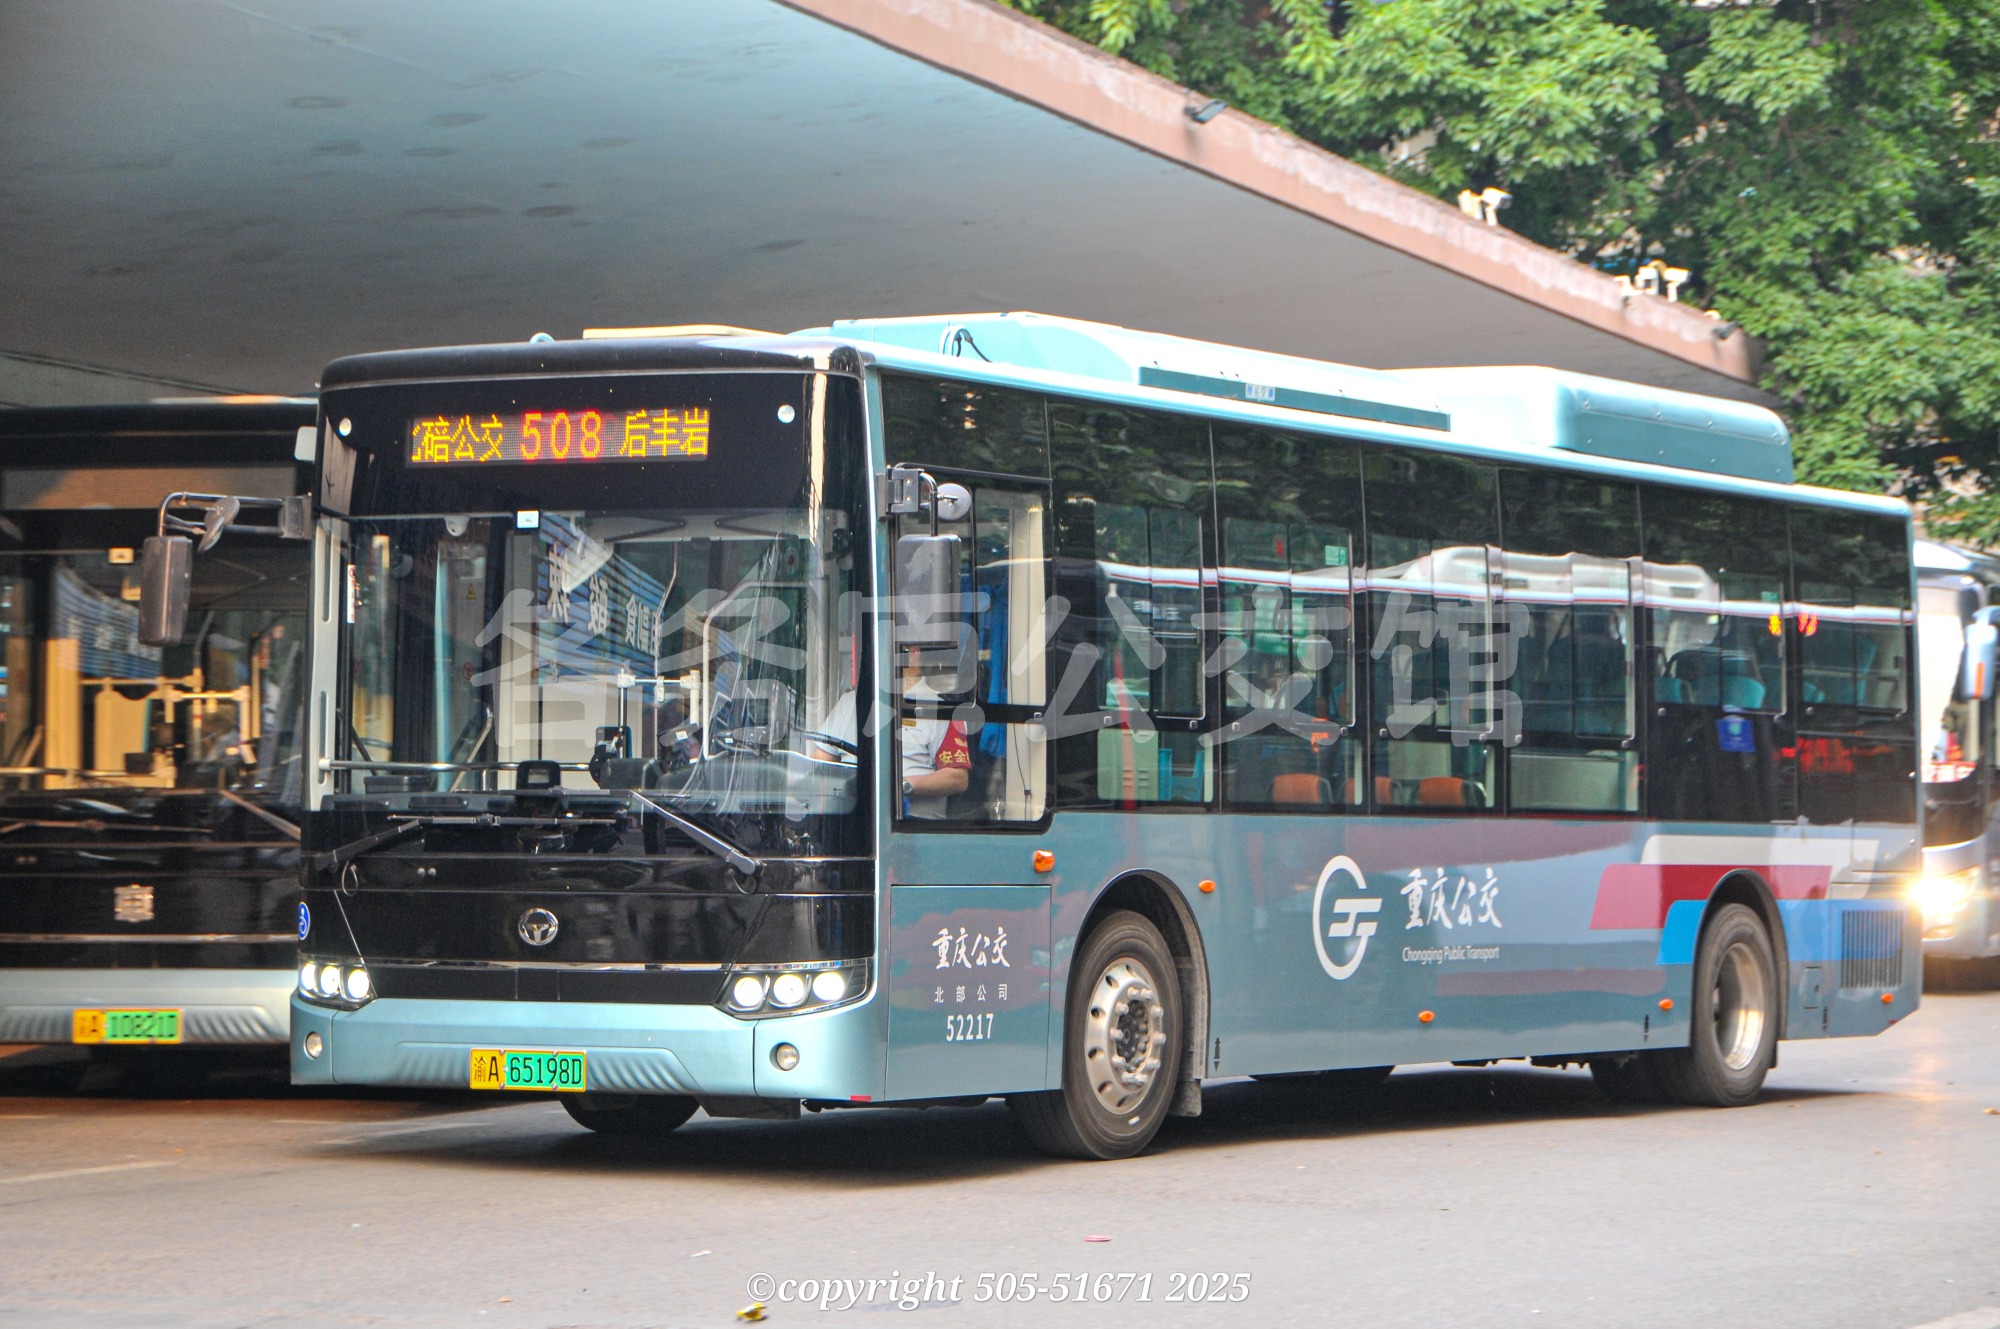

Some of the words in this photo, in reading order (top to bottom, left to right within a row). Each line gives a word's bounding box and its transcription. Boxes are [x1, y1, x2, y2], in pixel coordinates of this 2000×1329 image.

[520, 409, 601, 460] 508
[619, 407, 708, 457] 后丰岩
[1400, 867, 1502, 930] 重庆公交
[932, 927, 1010, 969] 重庆公交
[1402, 946, 1443, 965] Chongqing
[1444, 946, 1465, 961] Public
[1466, 945, 1500, 962] Transport
[934, 983, 1008, 1003] 北部公司
[946, 1013, 994, 1042] 52217
